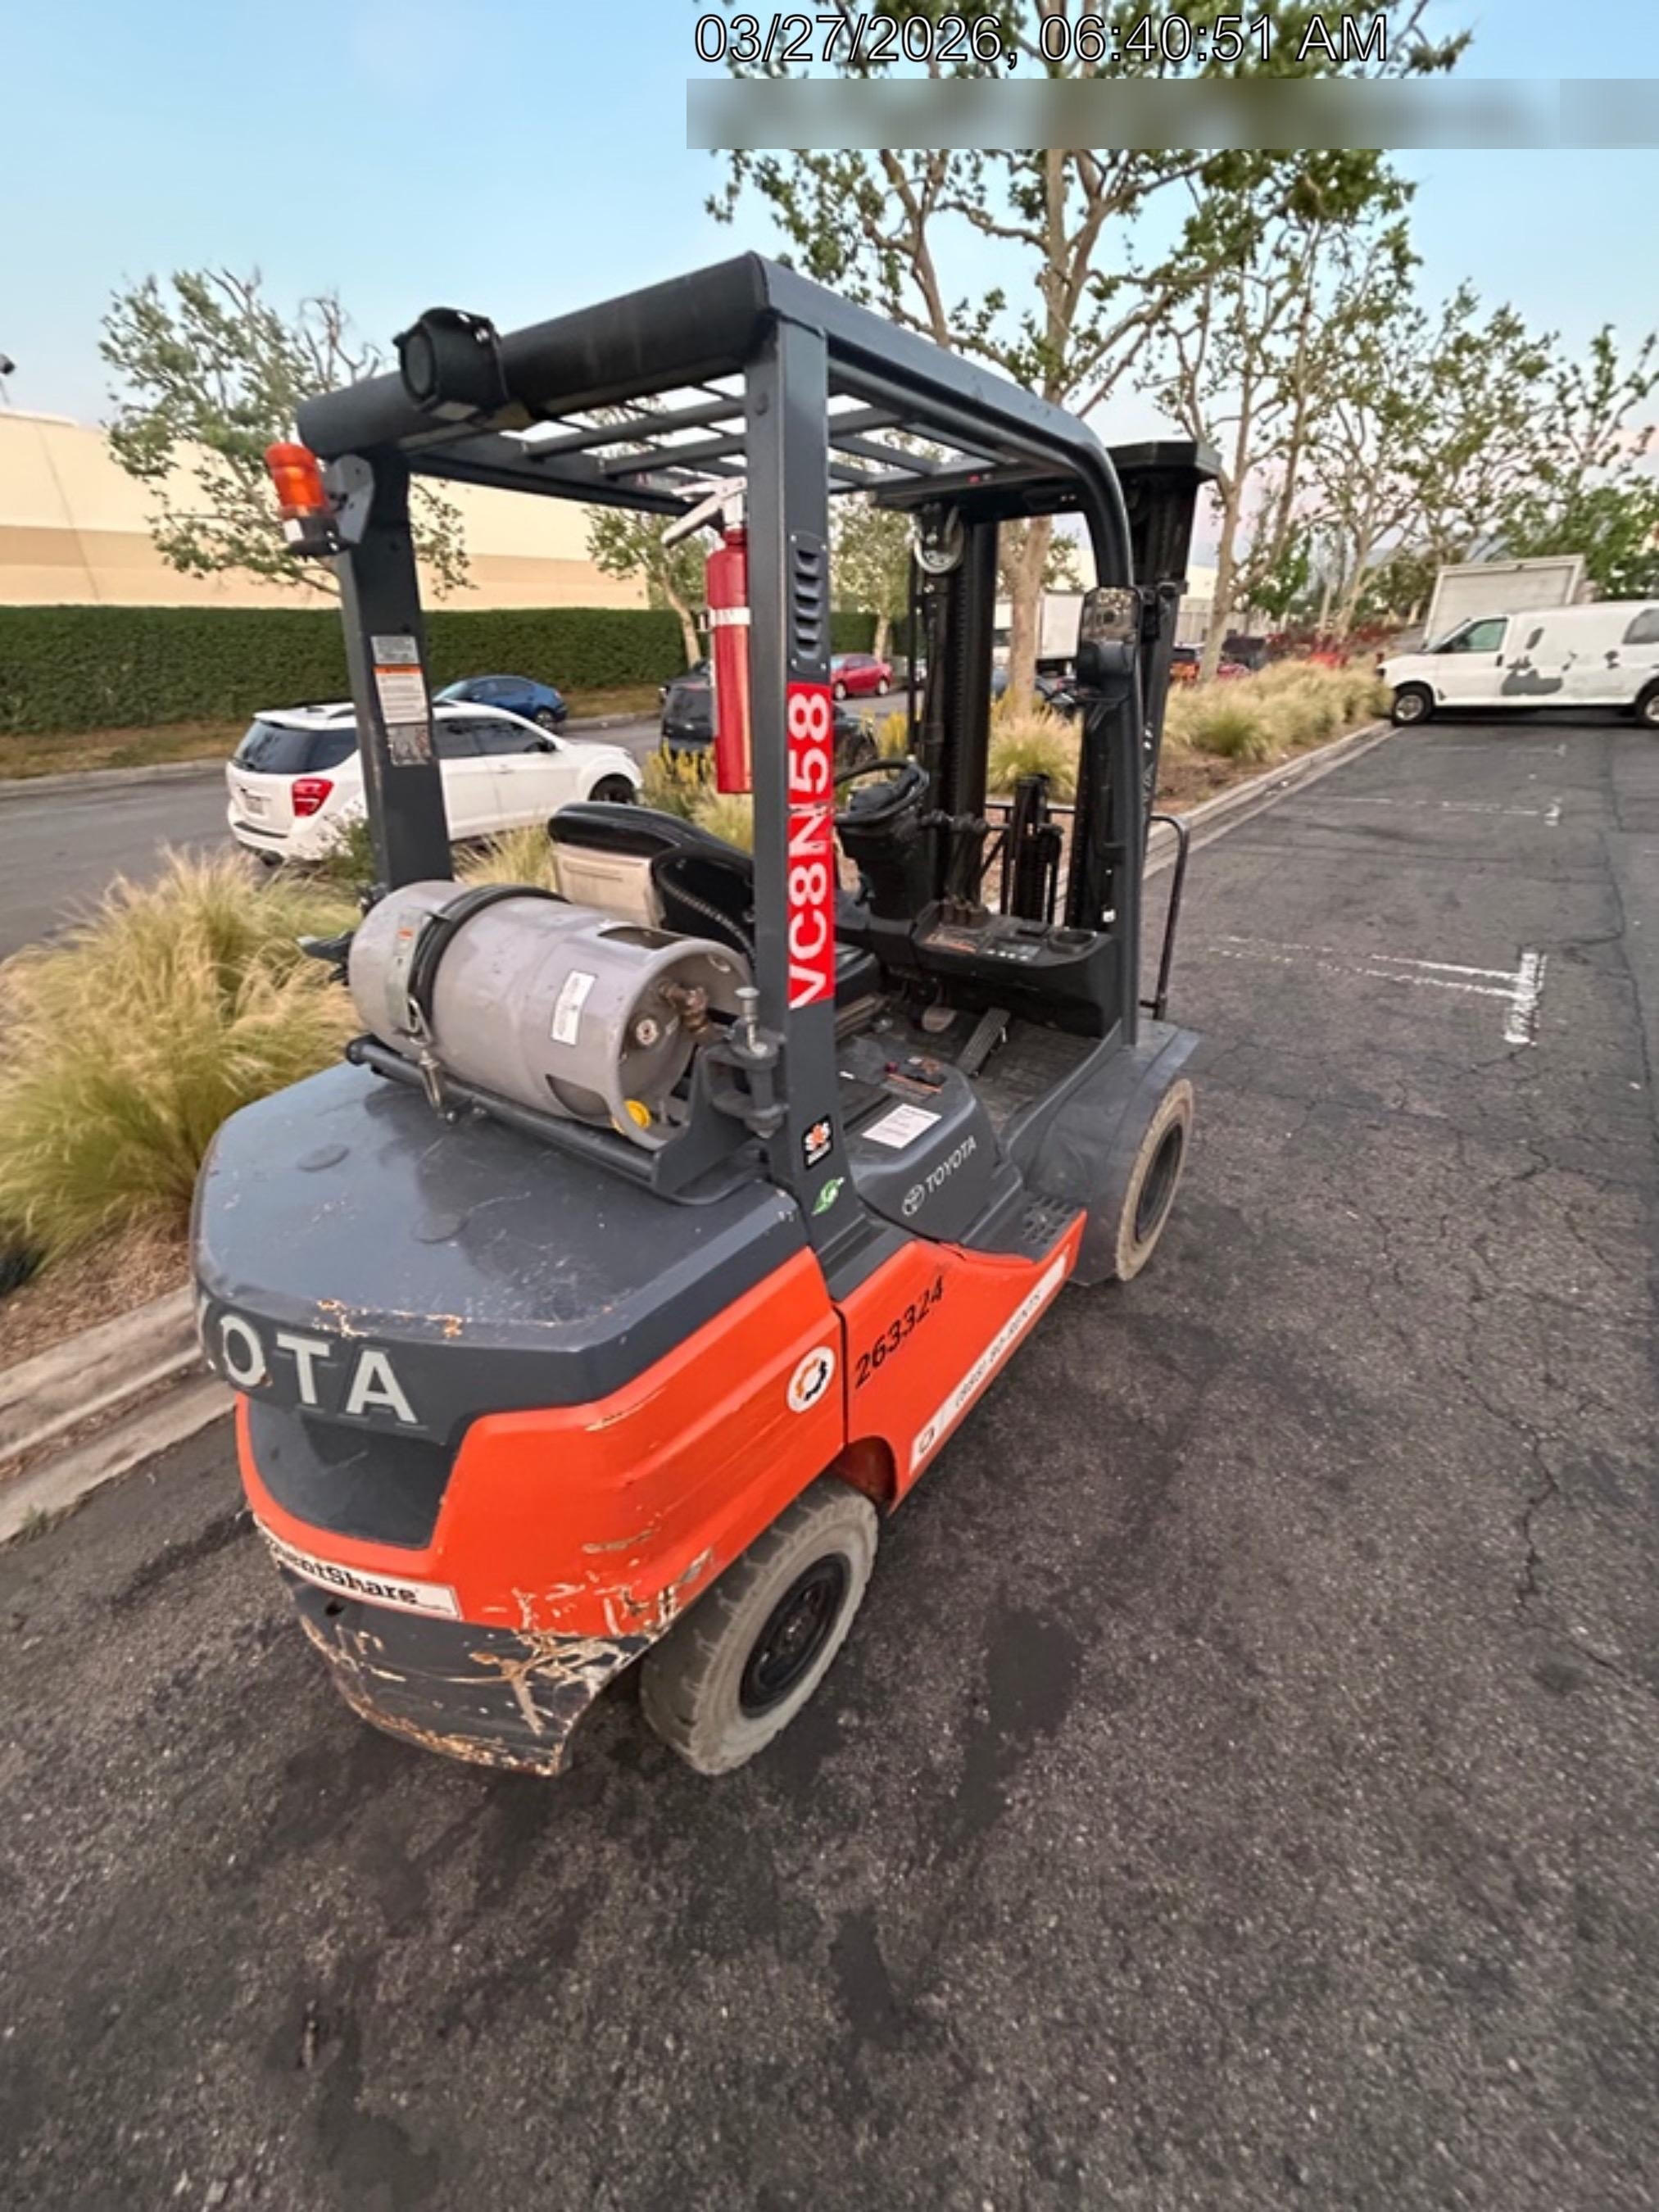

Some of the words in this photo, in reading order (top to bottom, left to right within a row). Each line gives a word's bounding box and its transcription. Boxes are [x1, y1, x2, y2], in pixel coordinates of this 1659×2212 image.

[787, 692, 830, 1009] VC8N58
[925, 1135, 977, 1194] TOYOTA
[210, 1313, 419, 1425] OTA
[854, 1274, 944, 1389] 263324
